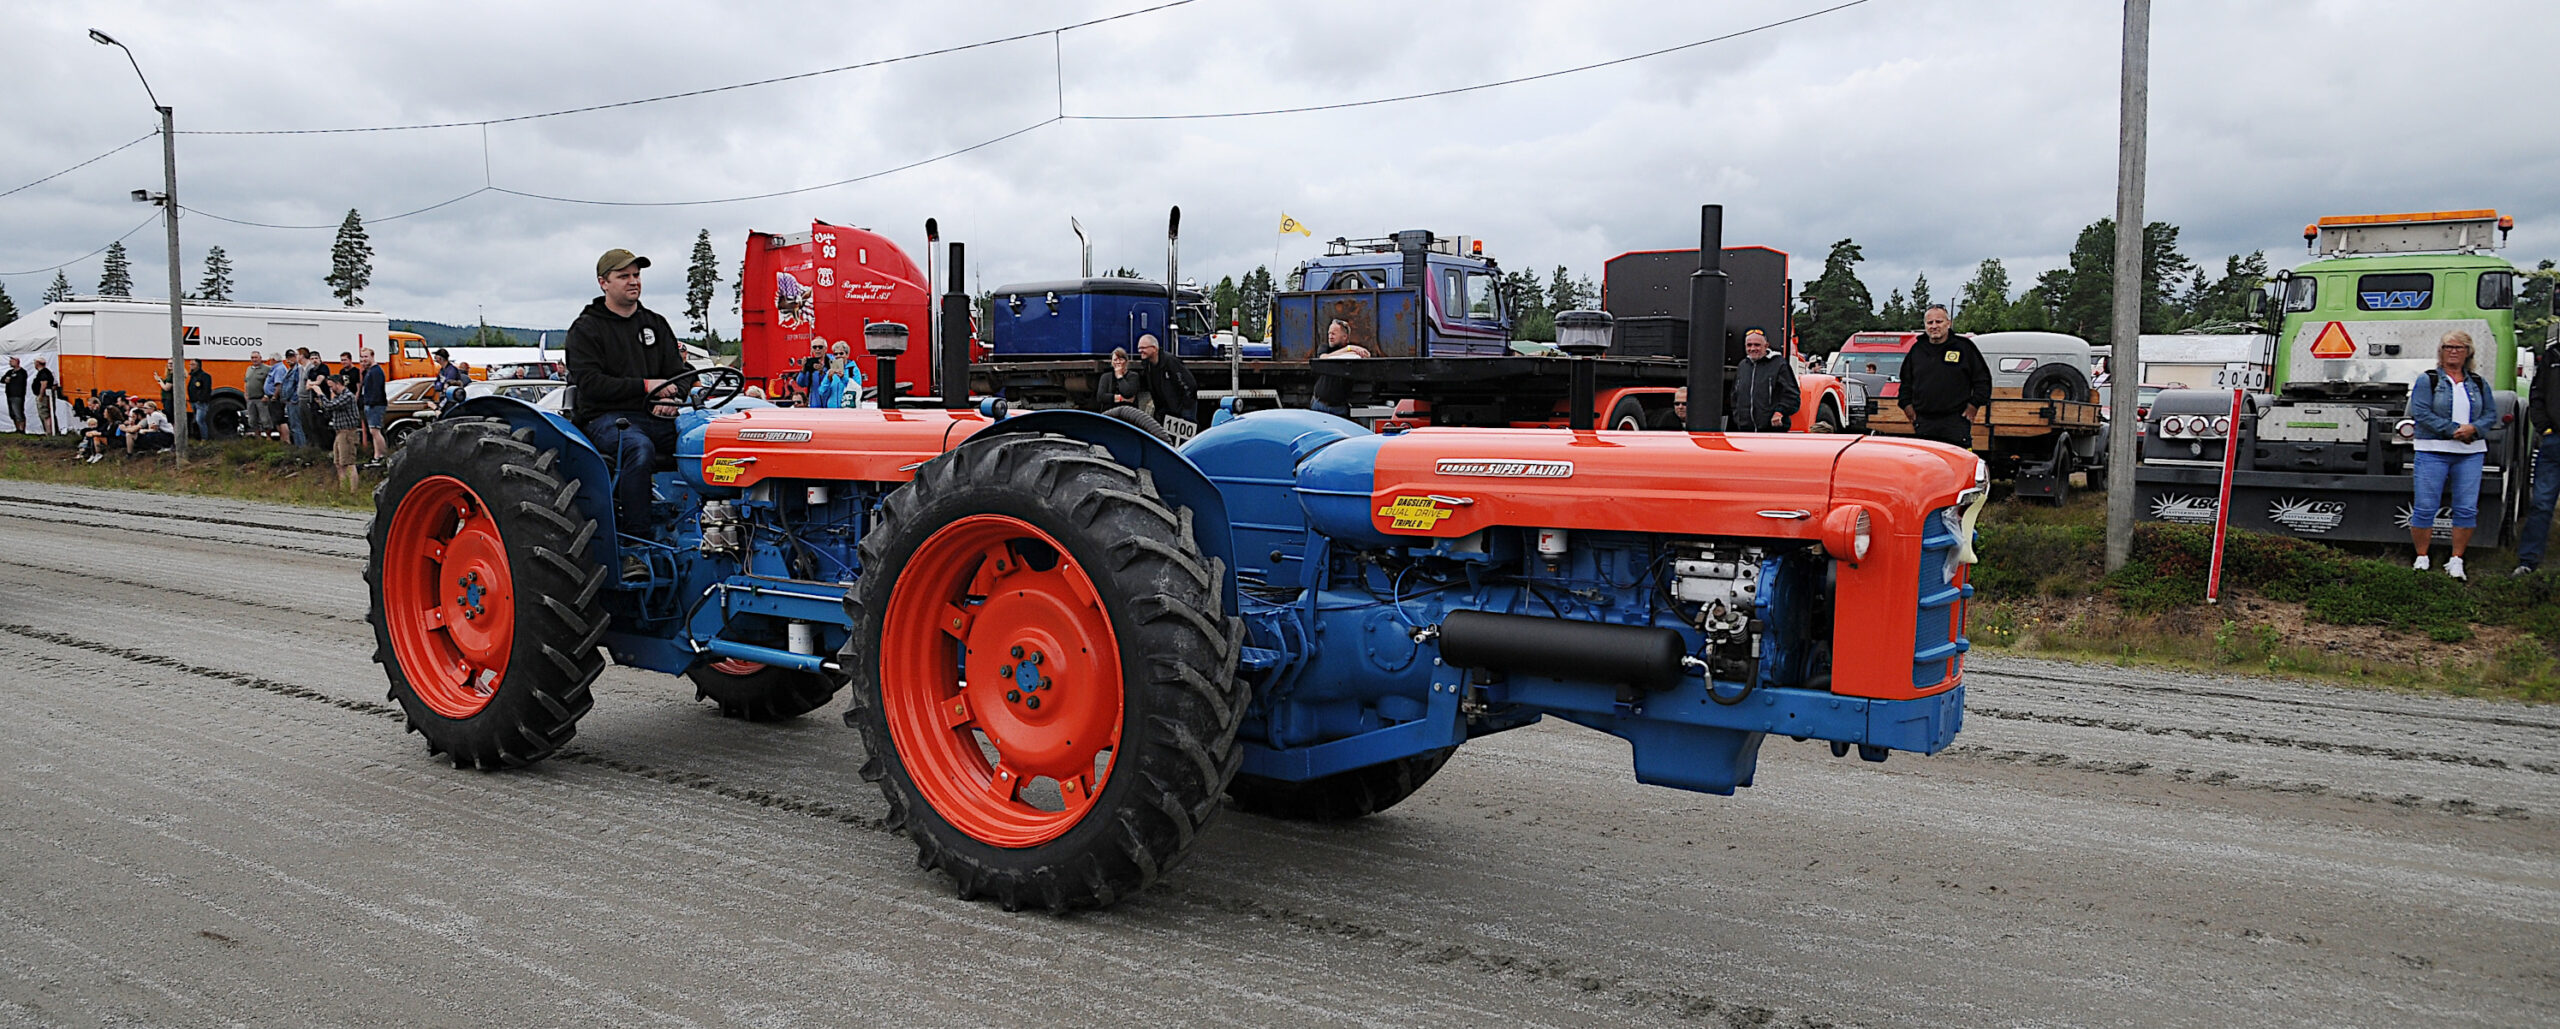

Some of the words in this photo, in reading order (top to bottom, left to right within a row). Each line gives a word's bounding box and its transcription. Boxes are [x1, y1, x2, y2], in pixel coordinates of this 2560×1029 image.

[823, 245, 837, 259] 93
[2362, 291, 2431, 308] VSV
[204, 336, 263, 346] INJEGODS
[1166, 419, 1193, 437] 1100
[765, 432, 786, 440] SUPER
[785, 433, 808, 441] MAJOR
[1439, 464, 1486, 472] FORDSON
[1486, 464, 1526, 475] SUPER
[1526, 465, 1568, 476] MAJOR
[1397, 498, 1433, 507] DAGSLETH
[2186, 498, 2219, 509] LBC
[2307, 502, 2346, 514] LBC
[1385, 508, 1409, 517] DUAL
[1414, 509, 1444, 518] DRIVE
[1394, 519, 1416, 527] TRIPLE
